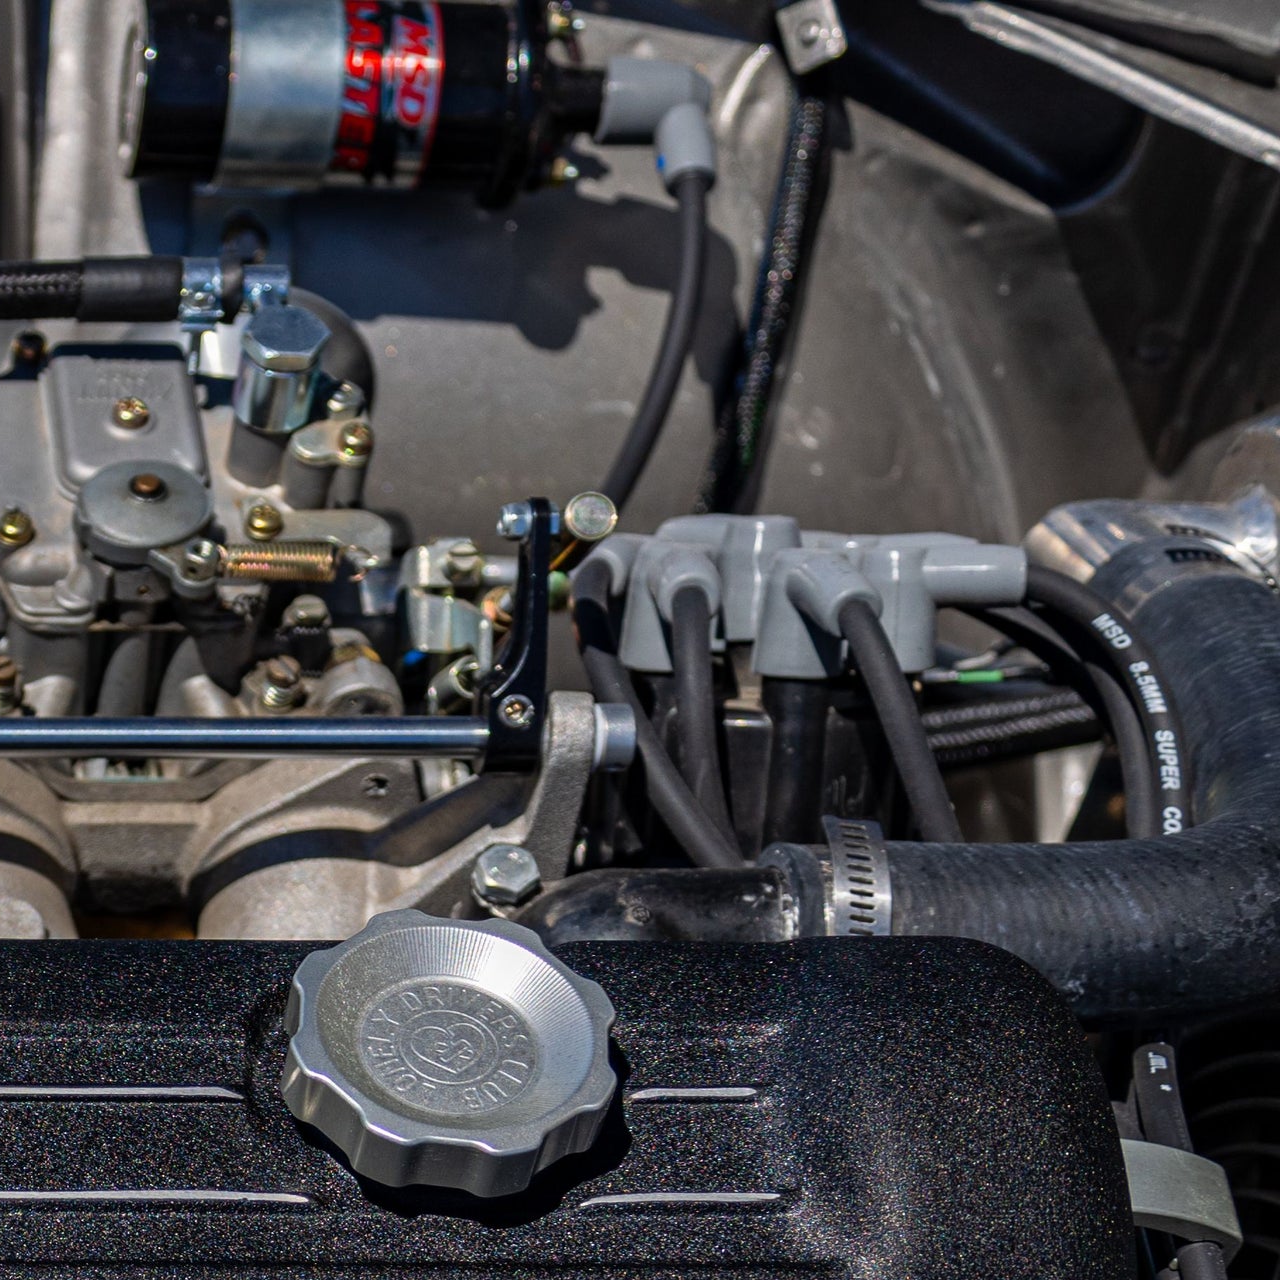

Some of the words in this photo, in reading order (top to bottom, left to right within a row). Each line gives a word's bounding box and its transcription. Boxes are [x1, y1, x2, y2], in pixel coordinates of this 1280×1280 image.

[396, 15, 434, 126] MSD
[1091, 612, 1133, 650] MSD
[1129, 661, 1167, 714] 8.5MM
[1154, 730, 1182, 791] SUPER
[1162, 805, 1183, 836] CO
[401, 985, 528, 1050] DRIVERS
